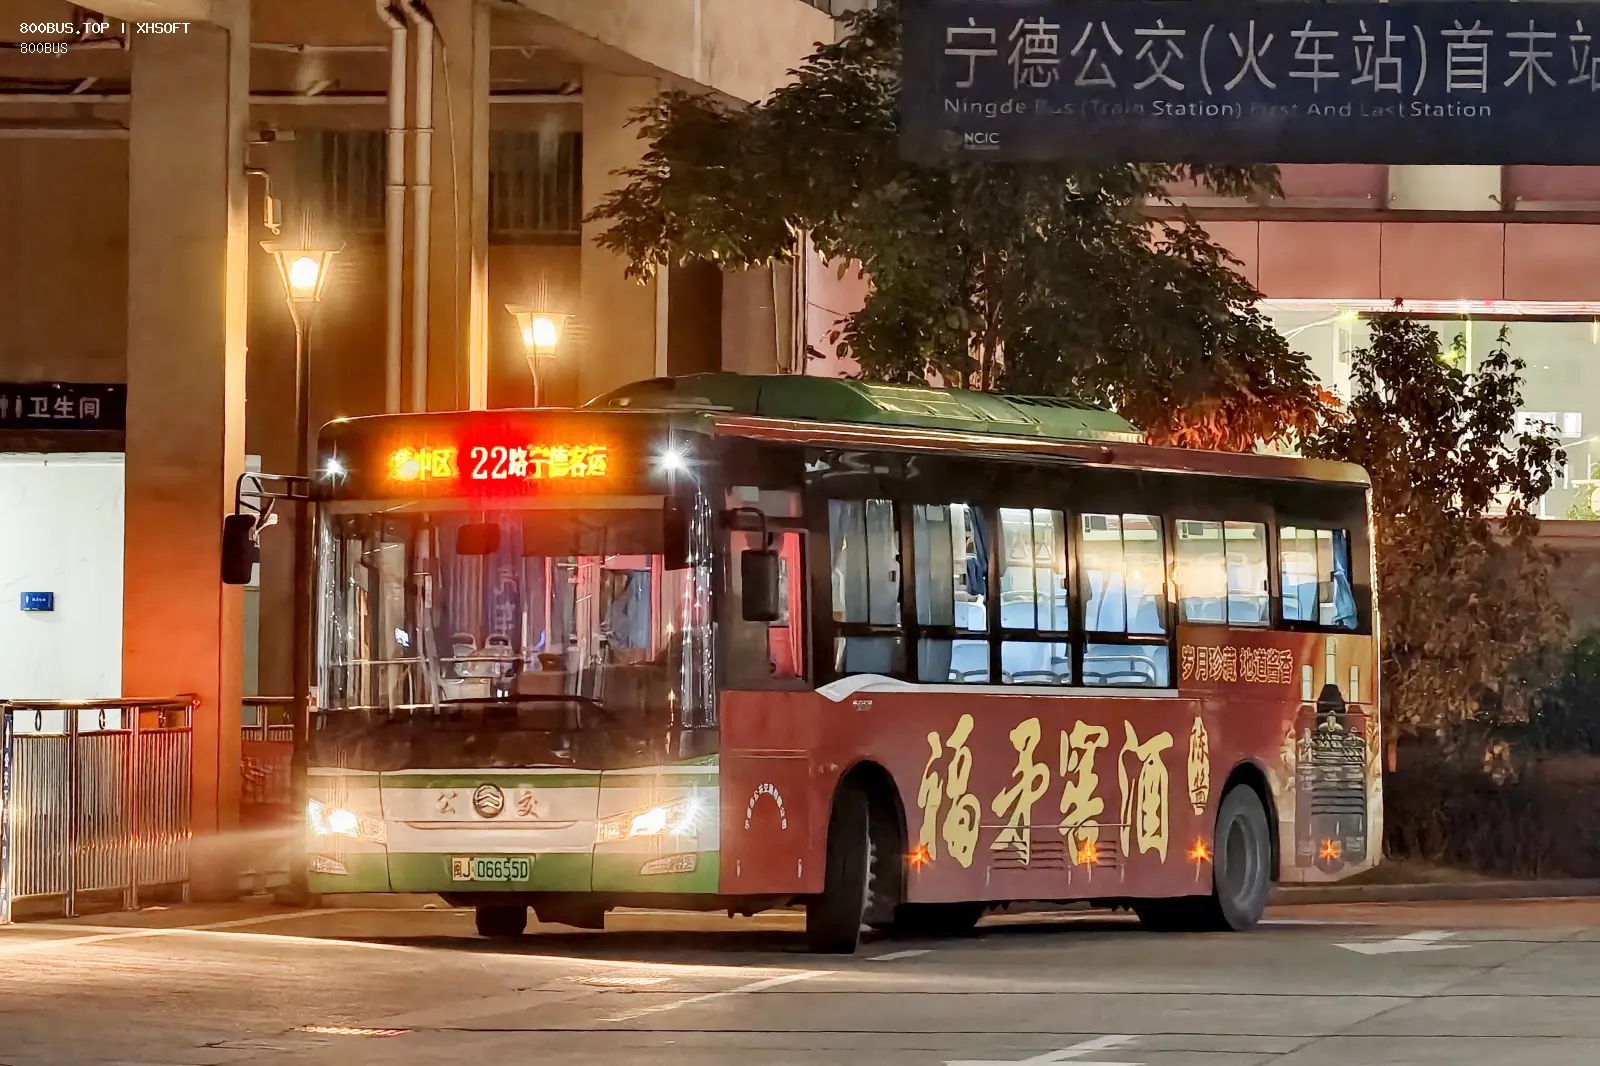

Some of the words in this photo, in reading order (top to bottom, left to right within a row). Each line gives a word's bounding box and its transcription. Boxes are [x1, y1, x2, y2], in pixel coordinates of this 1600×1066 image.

[944, 98, 1028, 118] Ningde
[1151, 99, 1242, 118] Station)
[1307, 102, 1352, 118] And
[1410, 101, 1492, 118] Station
[964, 132, 1001, 145] NCIC
[27, 395, 101, 419] 卫生间
[1181, 644, 1238, 682] 岁月珍藏
[1240, 647, 1294, 684] 地道酱香
